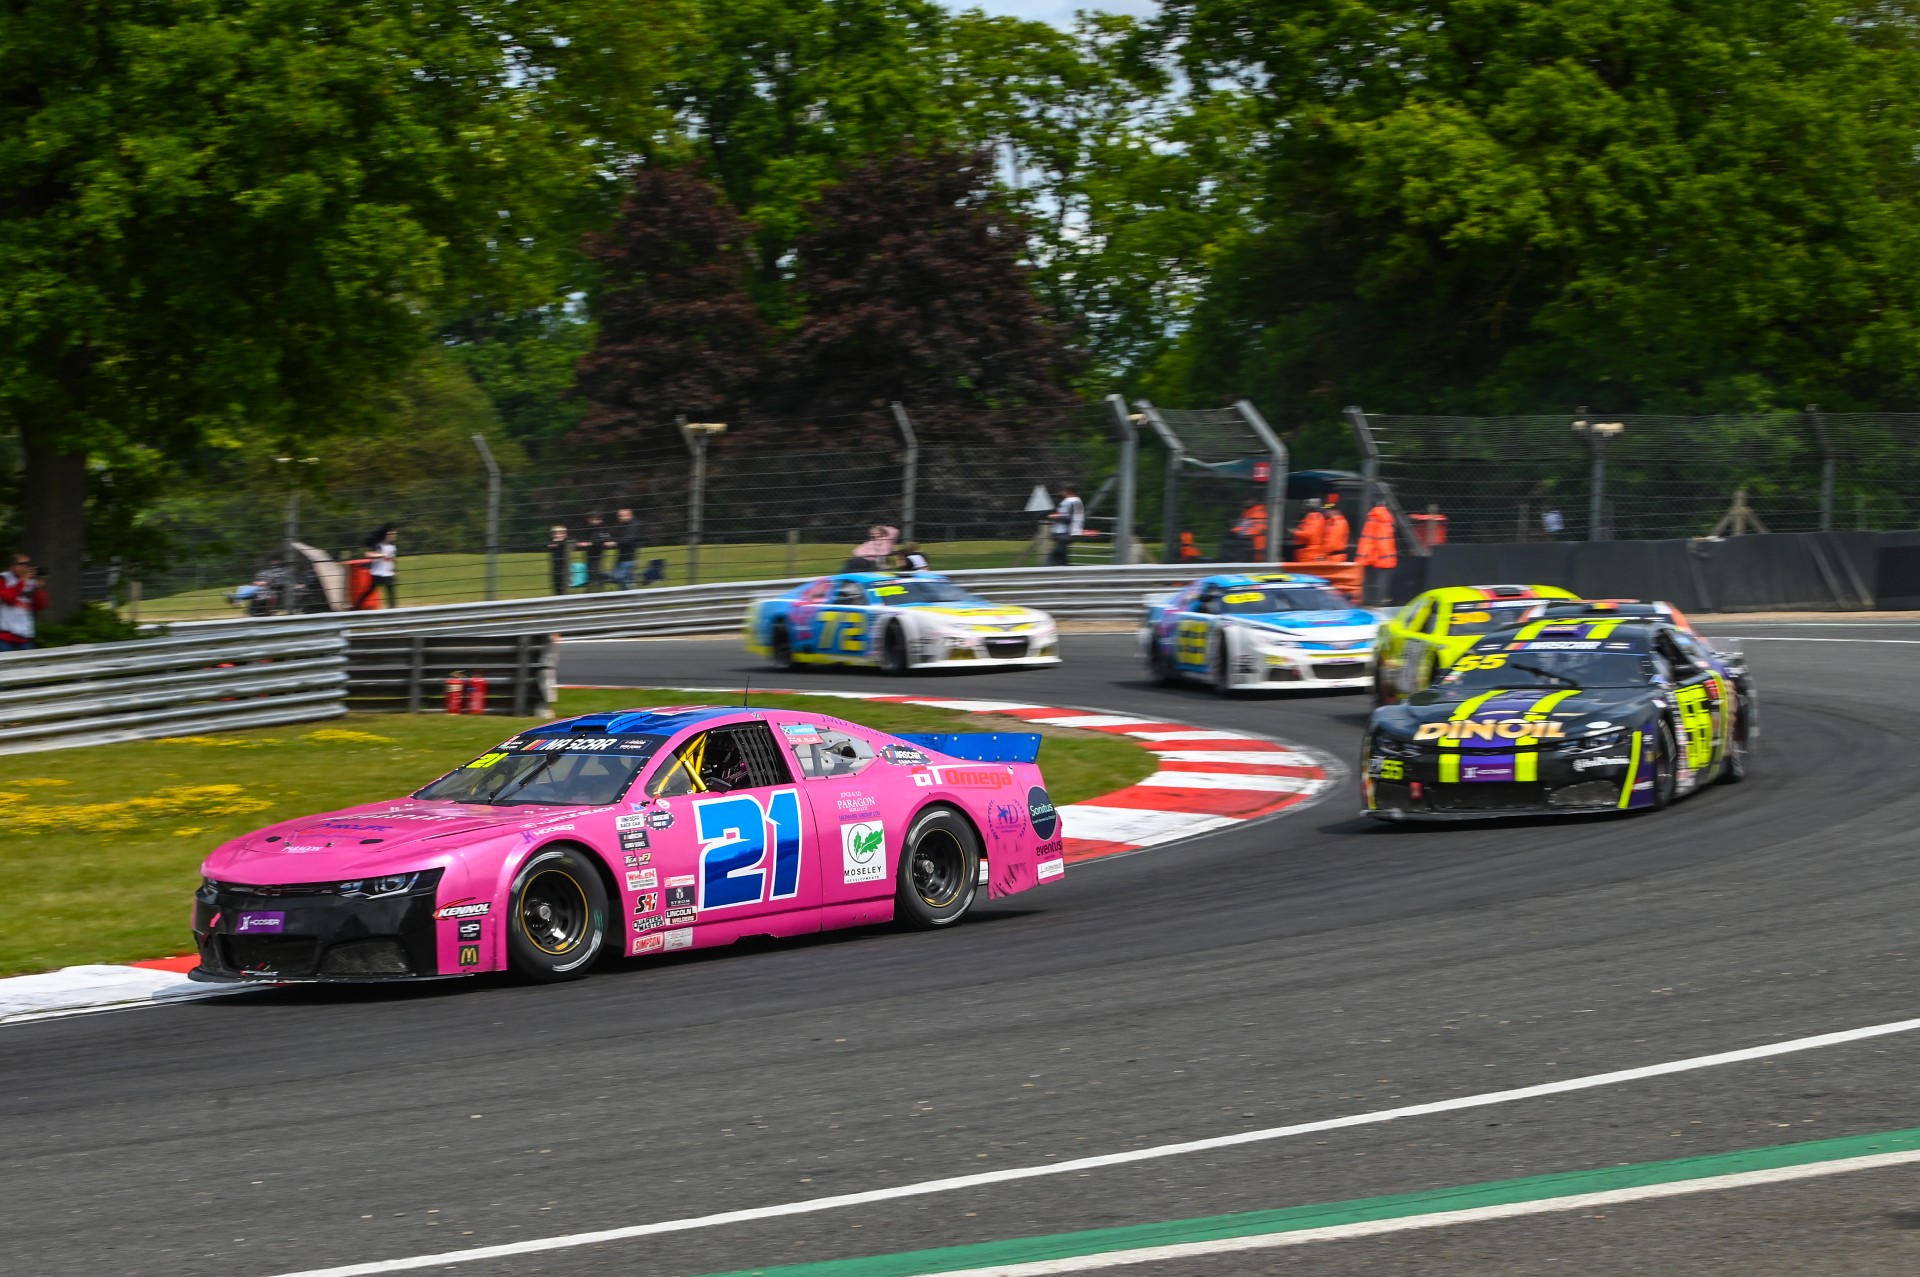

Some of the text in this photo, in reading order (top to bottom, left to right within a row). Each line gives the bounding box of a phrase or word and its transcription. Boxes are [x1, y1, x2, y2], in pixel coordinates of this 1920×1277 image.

[816, 611, 866, 651] 72
[1452, 653, 1509, 672] 55
[1413, 718, 1566, 741] DINOIL
[539, 739, 617, 750] NASCAR
[465, 752, 509, 769] 21
[895, 750, 922, 760] NASCAR
[908, 766, 1013, 789] GT Omega
[837, 796, 876, 809] PARAGON
[1029, 803, 1054, 817] Sonitus
[692, 787, 802, 912] 21
[1036, 841, 1062, 856] eventus
[844, 866, 882, 876] MOSELEY
[438, 904, 489, 917] KENNOL
[666, 908, 692, 918] LINCOLN
[635, 935, 660, 950] SIMPSON
